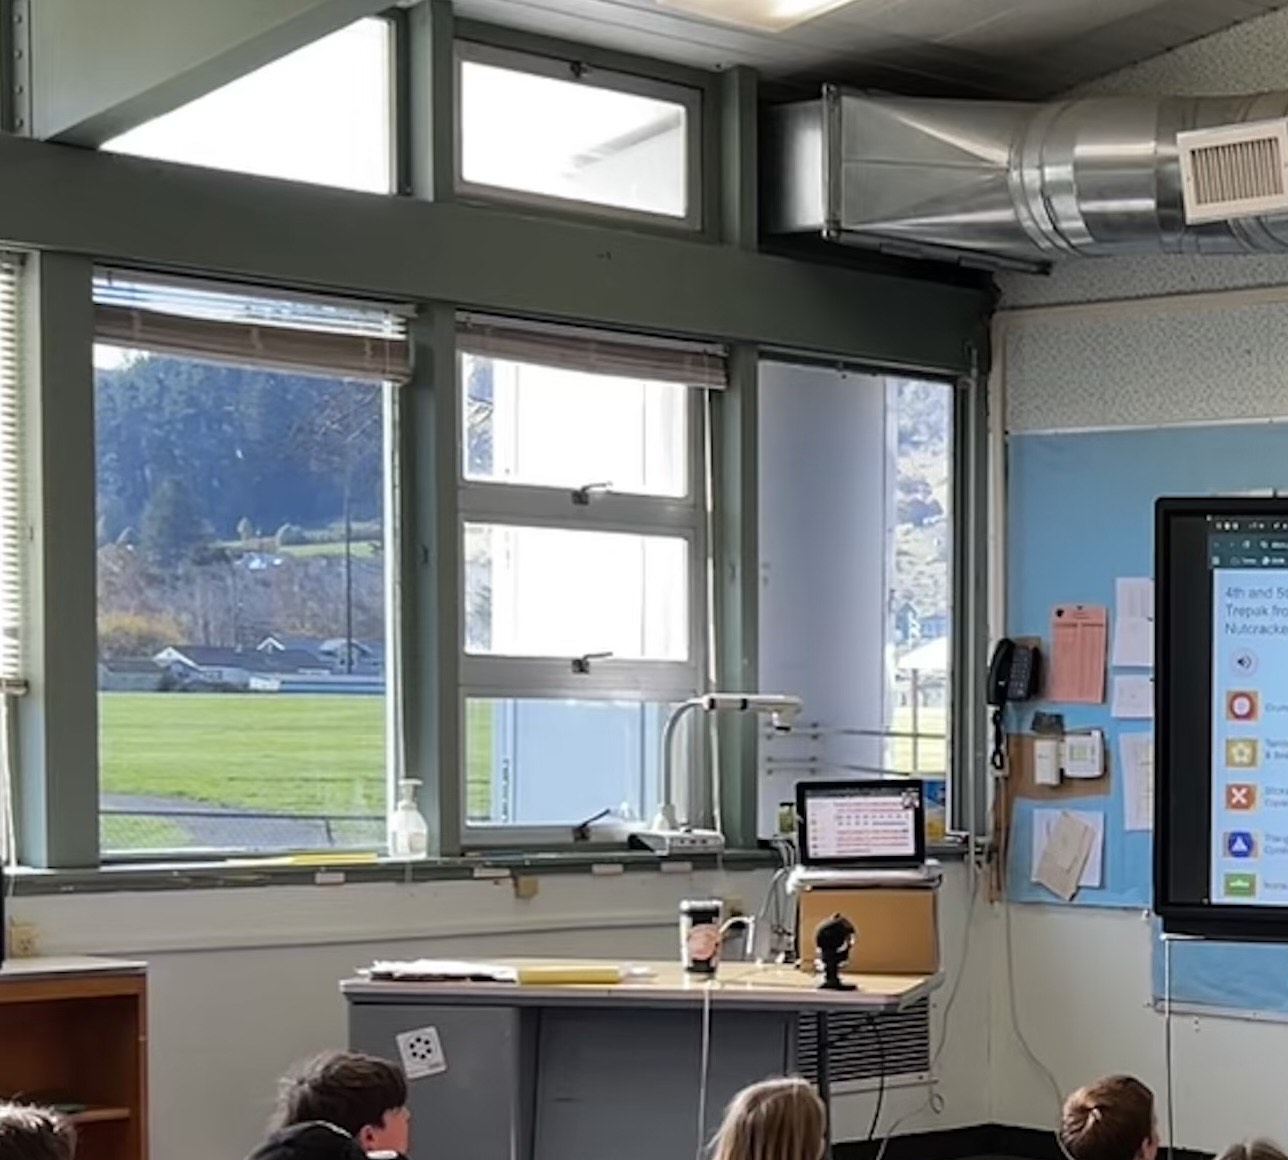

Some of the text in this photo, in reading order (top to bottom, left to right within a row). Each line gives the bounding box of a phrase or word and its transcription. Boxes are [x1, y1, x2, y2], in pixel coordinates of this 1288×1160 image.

[1225, 586, 1245, 598] 4th
[1249, 586, 1273, 599] and
[1225, 603, 1268, 618] Trepak
